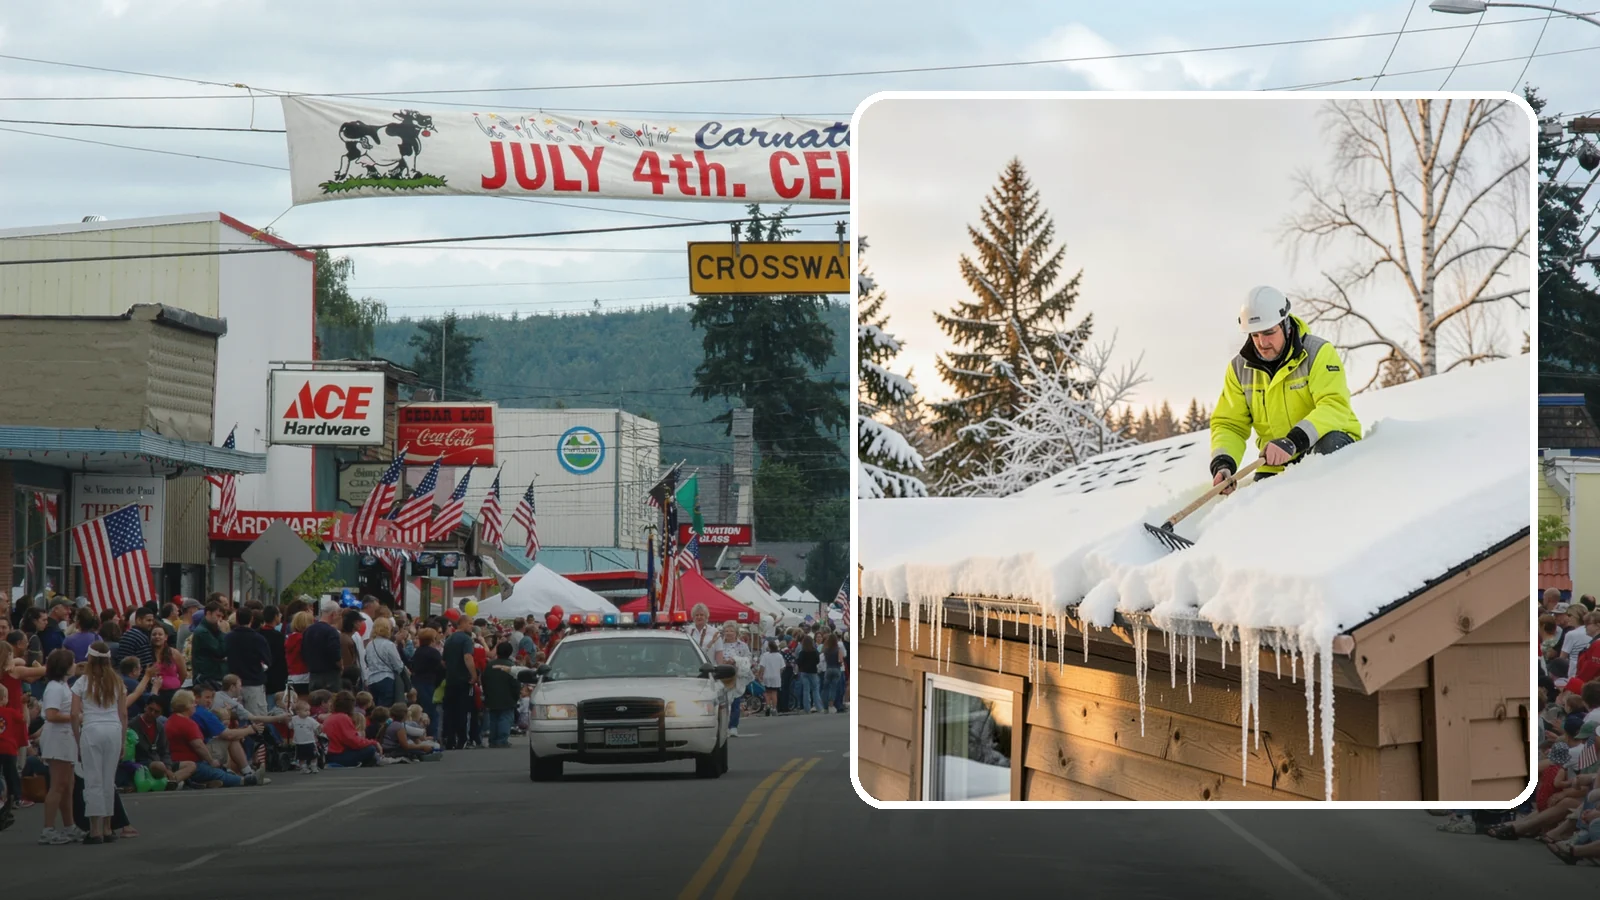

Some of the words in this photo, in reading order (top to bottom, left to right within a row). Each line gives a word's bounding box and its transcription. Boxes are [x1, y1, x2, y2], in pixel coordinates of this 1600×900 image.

[694, 121, 850, 149] Carnat
[481, 141, 605, 192] JULY
[632, 149, 747, 198] 4th.
[697, 254, 850, 280] CROSSWA
[283, 380, 373, 420] ACE
[405, 409, 452, 422] CEDAR
[283, 421, 371, 437] Hardware
[416, 428, 477, 447] Coca-Cola
[353, 467, 385, 480] Simpl
[95, 485, 125, 495] Vincent
[126, 486, 136, 495] de
[137, 486, 155, 495] Paul
[688, 526, 742, 536] CRNATION
[699, 535, 731, 543] GLASS
